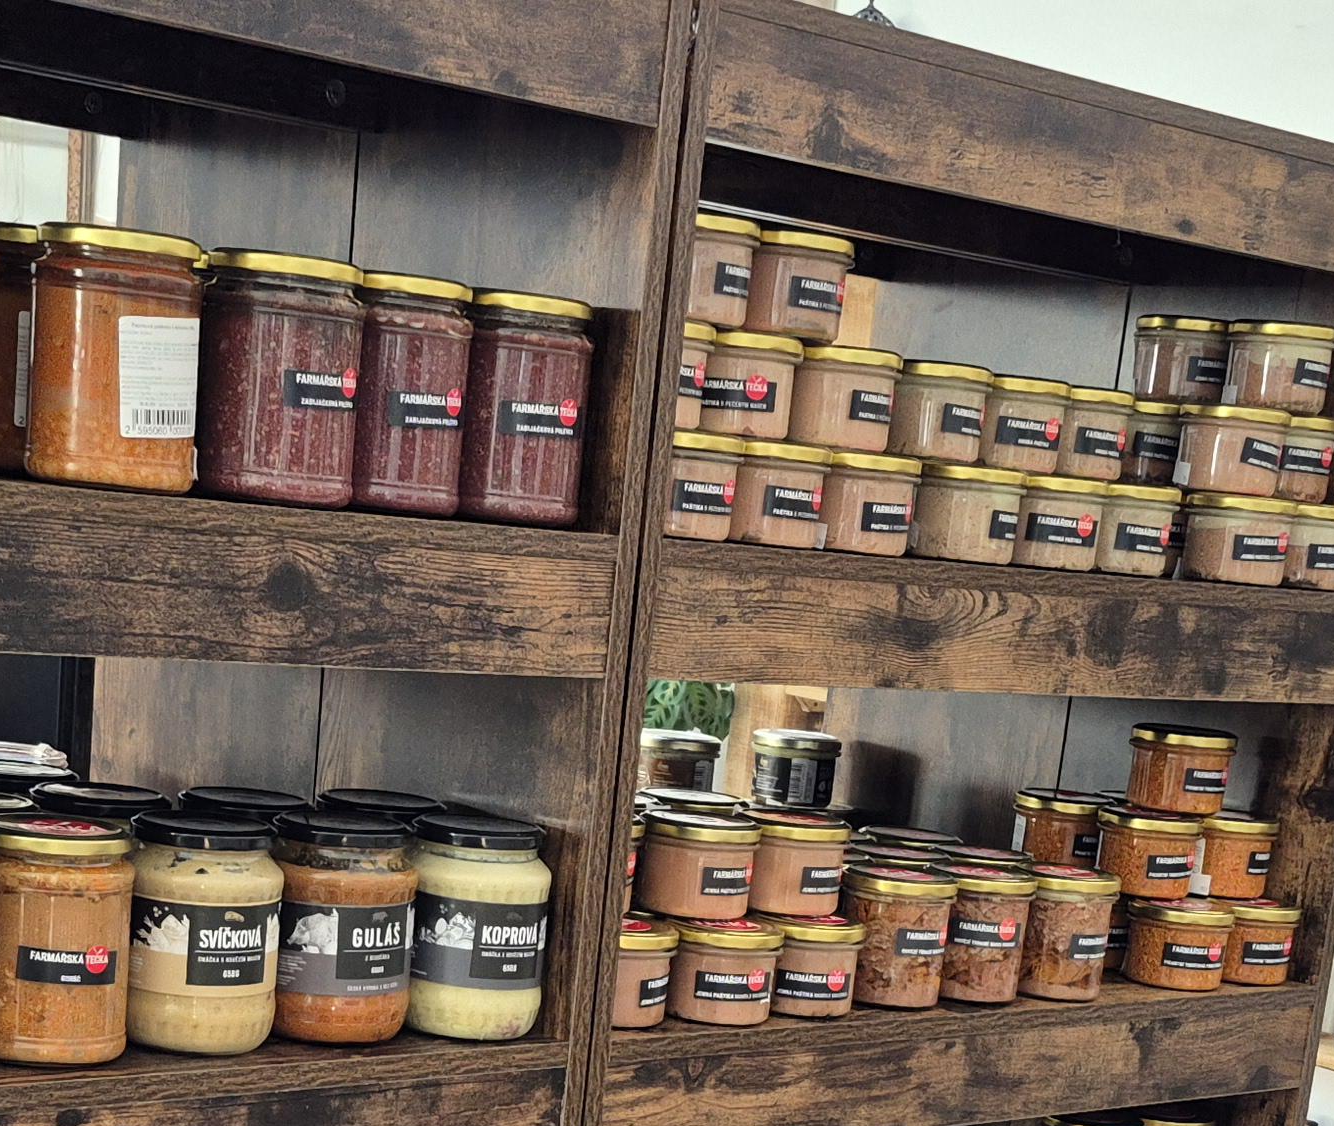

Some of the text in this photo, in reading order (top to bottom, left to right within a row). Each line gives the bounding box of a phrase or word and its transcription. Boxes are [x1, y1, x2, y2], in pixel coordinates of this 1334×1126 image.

[801, 279, 837, 293] FARMÁŘSKÁ
[296, 372, 342, 388] FARMÁŘSKÁ
[400, 393, 446, 407] FARMÁŘSKÁ
[511, 402, 559, 417] FARMÁŘSKÁ
[125, 425, 131, 434] 2
[1007, 418, 1045, 432] FARMÁŘSKÁ
[684, 482, 723, 496] FARMÁŘSKÁ
[482, 923, 538, 945] KOPROVÁ
[959, 920, 1000, 934] FARMÁŘSKÁ
[199, 925, 262, 949] SVÍČKOVÁ
[351, 923, 400, 948] GULÁŠ
[29, 950, 85, 965] FARMÁŘSKÁ
[704, 974, 748, 985] FARMÁŘSKÁ
[785, 972, 827, 984] FARMÁŘSKÁ
